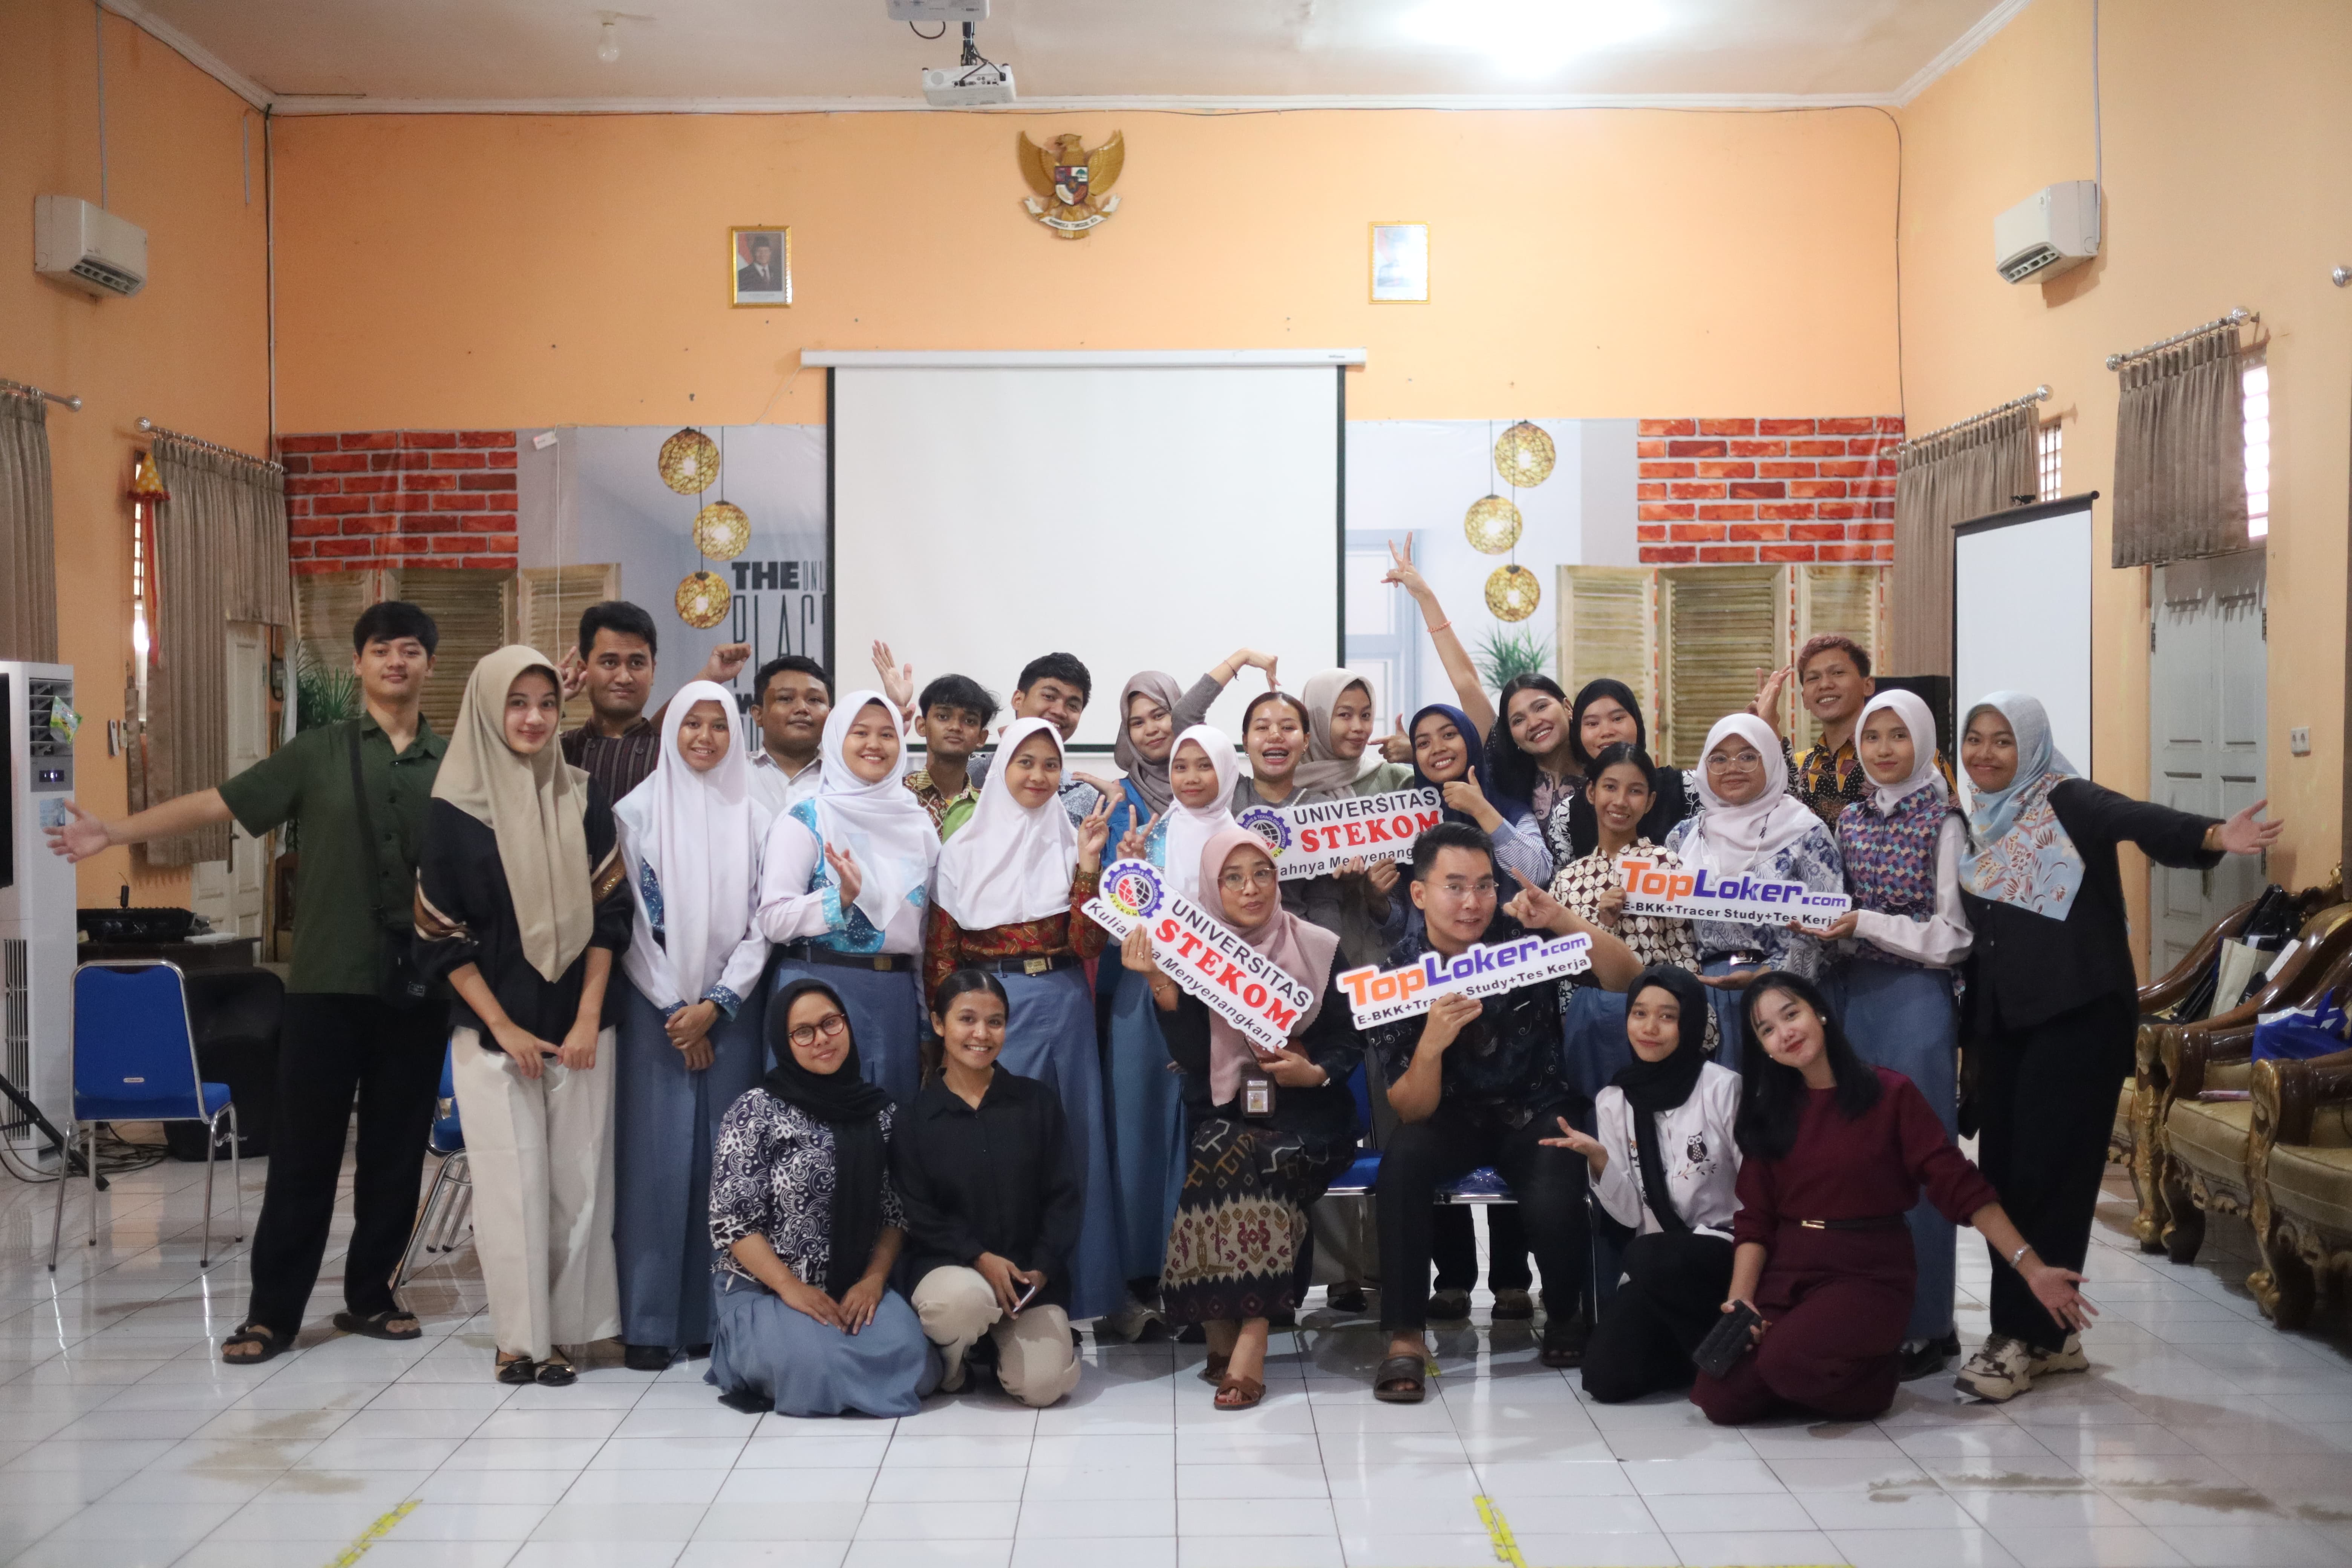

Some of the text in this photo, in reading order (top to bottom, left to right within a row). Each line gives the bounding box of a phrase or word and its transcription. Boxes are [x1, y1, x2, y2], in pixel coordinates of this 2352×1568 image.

[732, 560, 825, 591] THE ONL
[733, 594, 826, 687] PLAC
[1244, 817, 1254, 828] SAINS
[1257, 815, 1280, 826] TEKNOLOGI
[1294, 790, 1437, 825] UNIVERSITAS
[1301, 810, 1439, 853] STEKOM
[1110, 869, 1127, 892] UNIVERSITAS
[1144, 873, 1158, 897] TEKNOLOGI
[1280, 861, 1325, 876] ahnya
[1622, 861, 1847, 907] TopLoker.com
[1139, 897, 1158, 914] KOMPUTER
[1172, 899, 1309, 1007] UNIVERSITAS
[1155, 919, 1297, 1031] STEKOM
[1343, 938, 1586, 1006] TopLoker.com
[1466, 970, 1544, 995] Study+Tes
[1547, 959, 1588, 975] Kerja
[1162, 958, 1272, 1043] Menyenangkan
